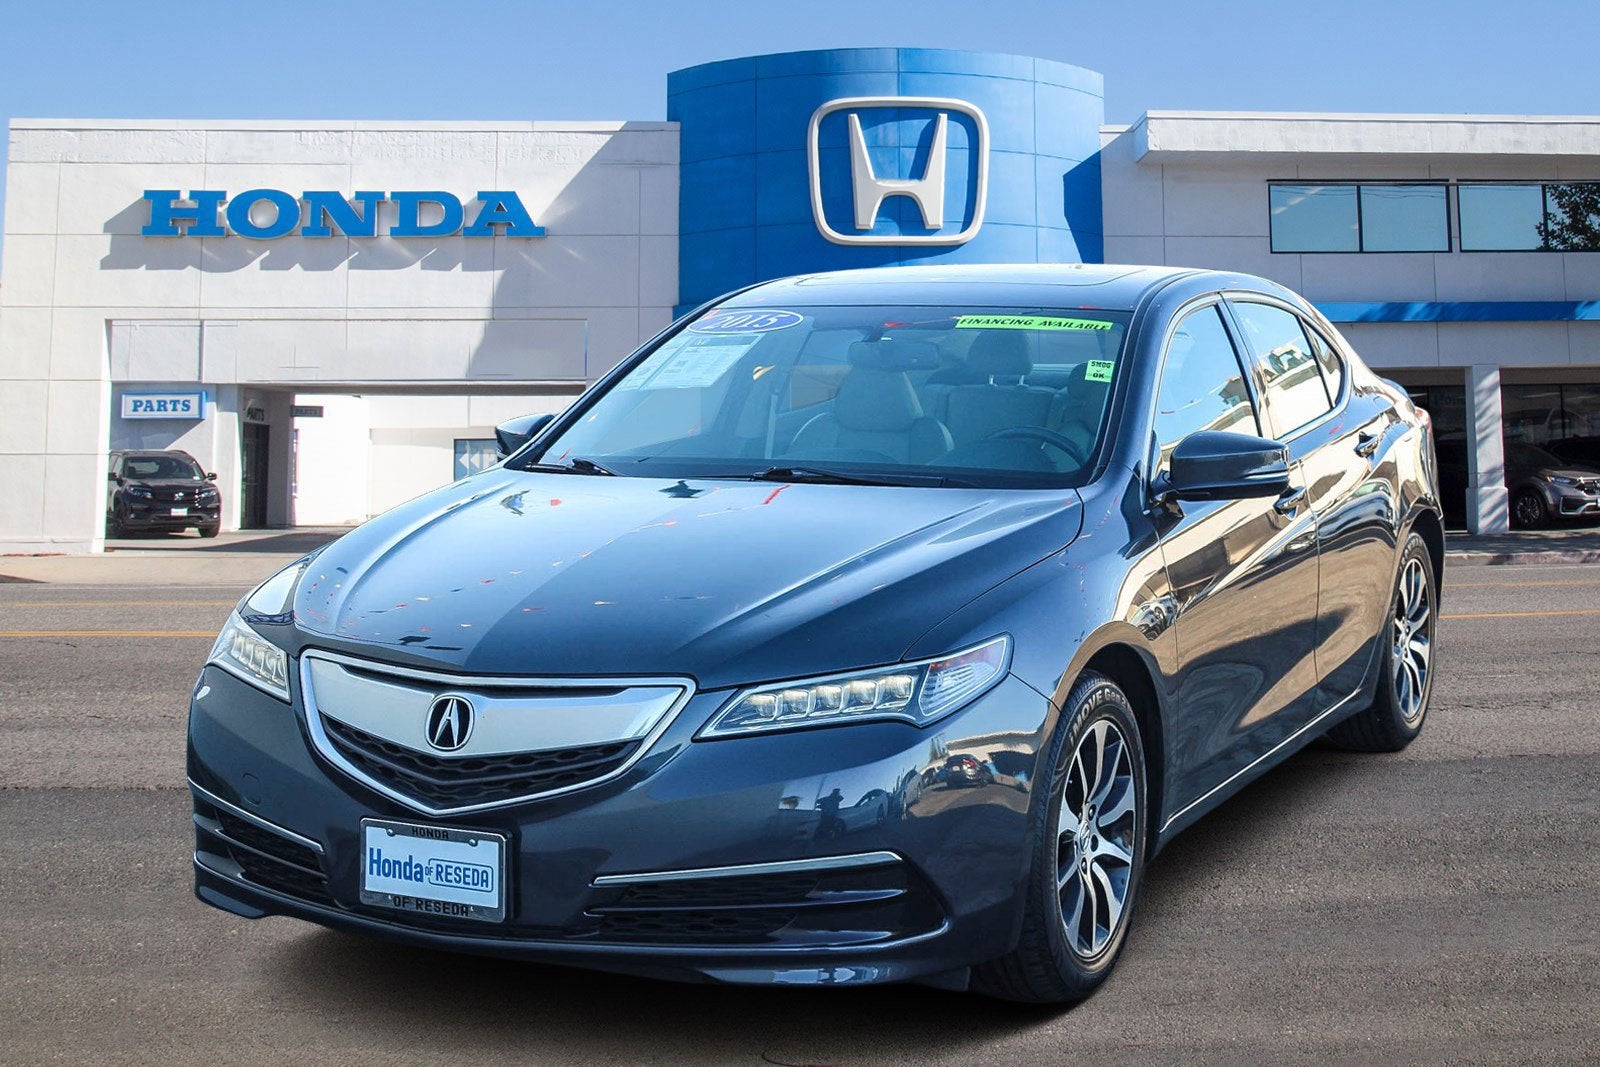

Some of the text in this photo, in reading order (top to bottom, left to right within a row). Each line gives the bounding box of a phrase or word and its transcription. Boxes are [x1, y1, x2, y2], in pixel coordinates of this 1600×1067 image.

[141, 188, 548, 240] HONDA
[703, 314, 790, 329] 2015
[960, 317, 1110, 330] FINANCING AVAILABLE
[131, 399, 192, 413] PARTS
[411, 827, 450, 840] HONDA
[369, 847, 489, 888] Honda OF RESEDA
[393, 896, 469, 917] OF RESEDA
